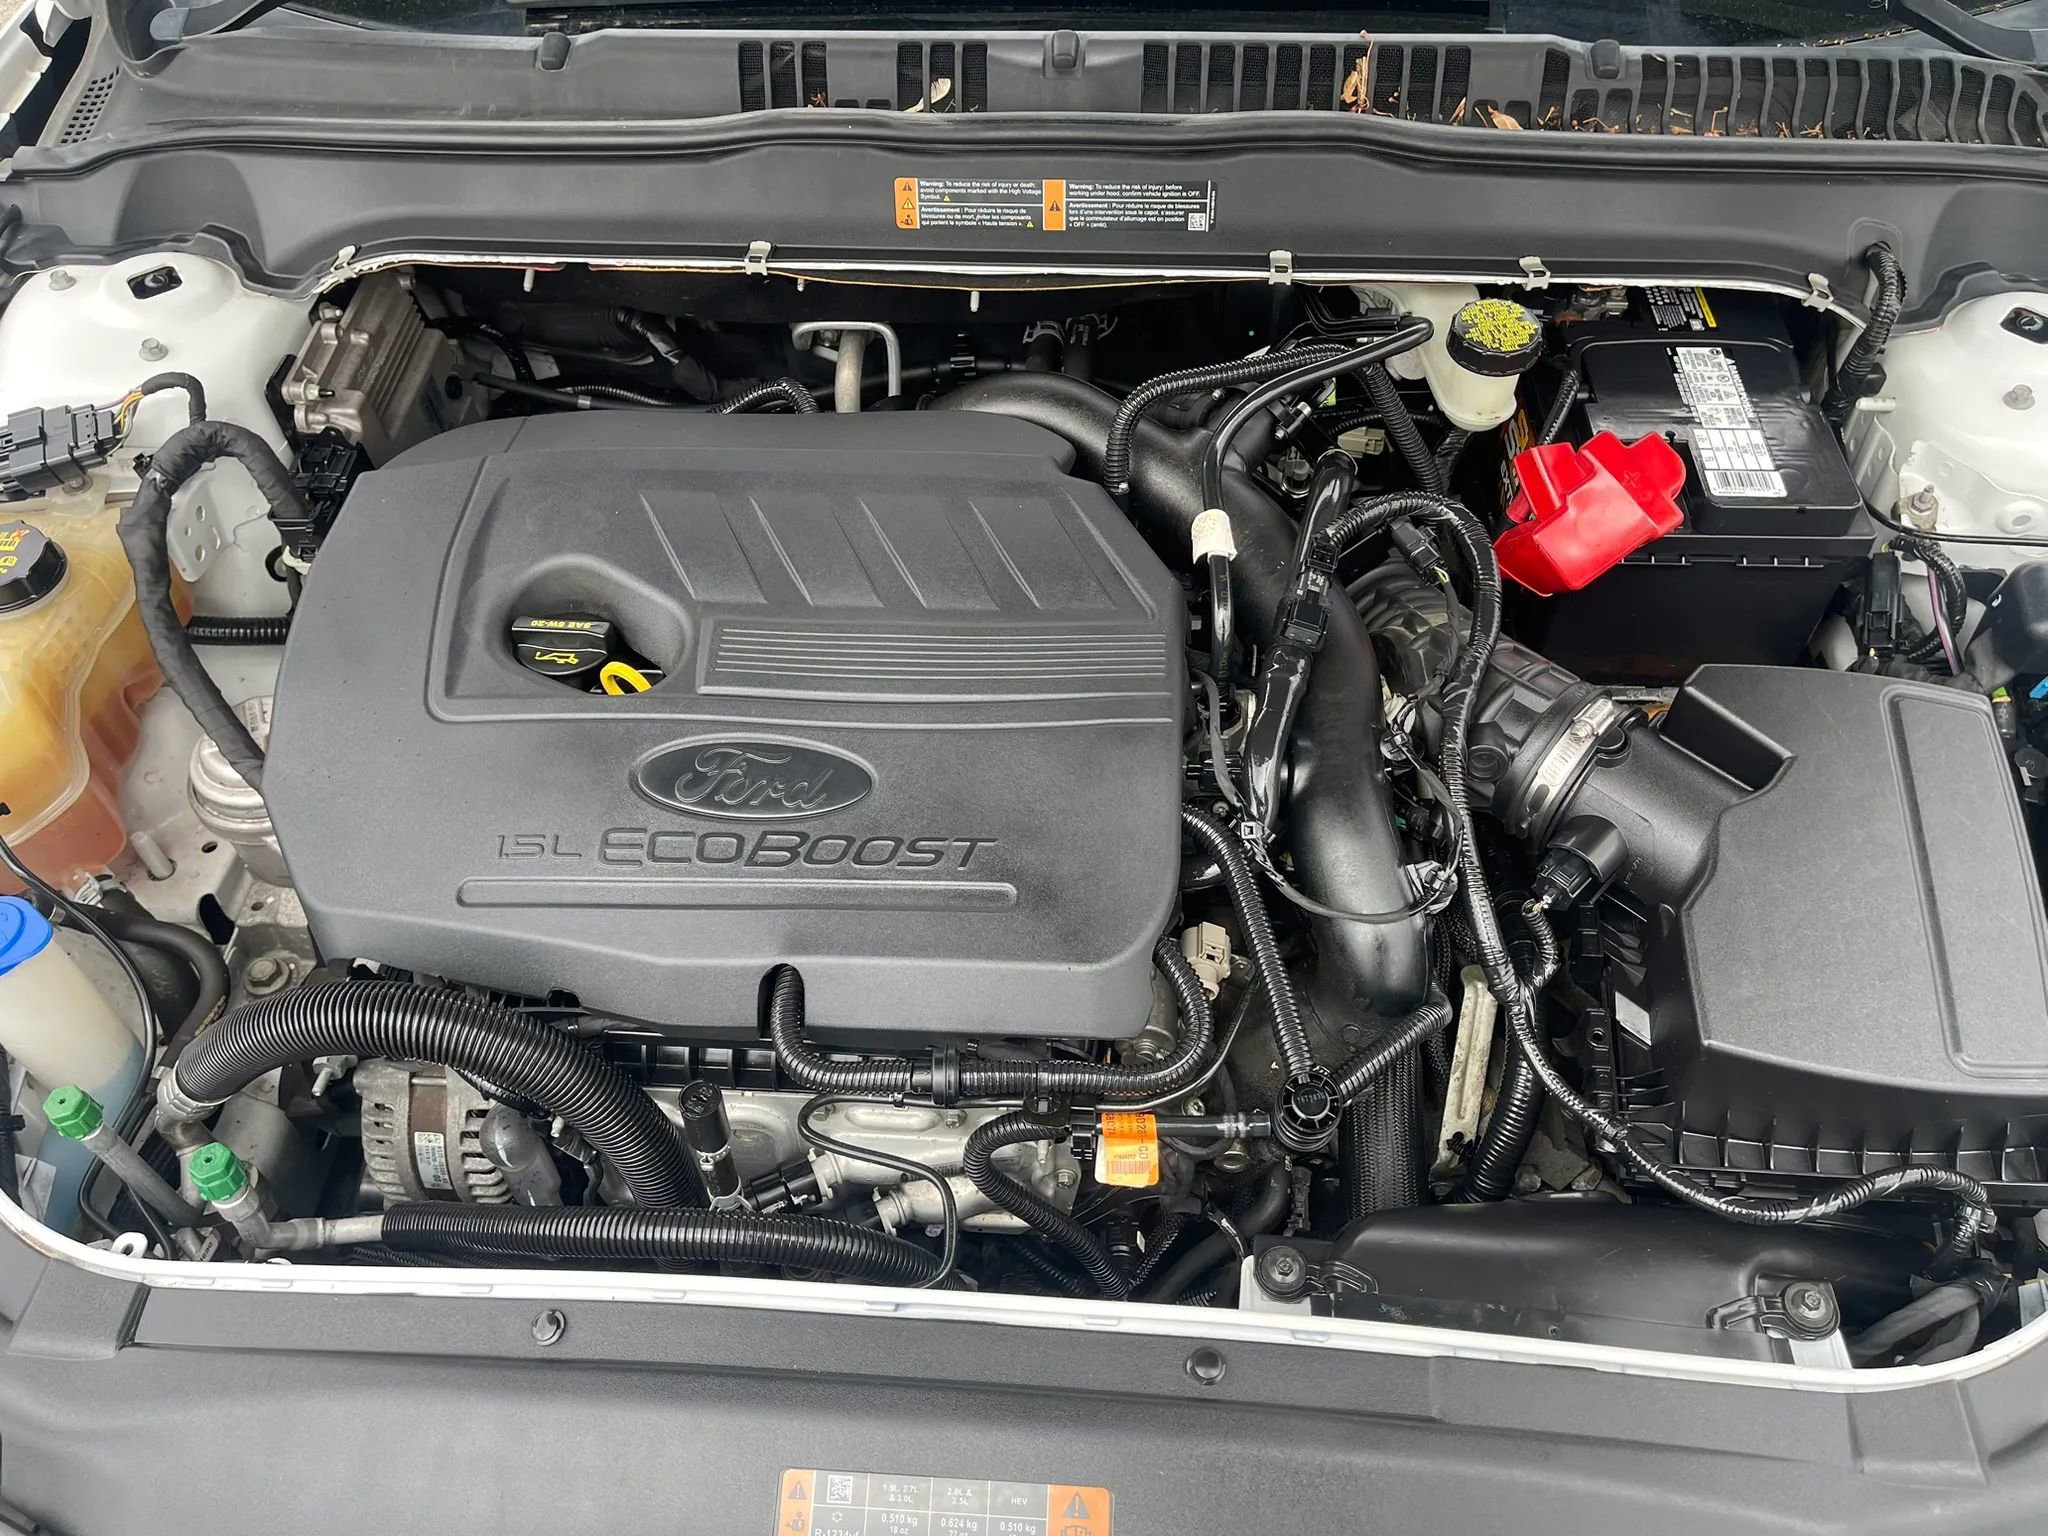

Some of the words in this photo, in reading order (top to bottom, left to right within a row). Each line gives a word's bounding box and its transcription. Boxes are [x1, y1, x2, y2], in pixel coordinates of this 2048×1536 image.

[530, 619, 567, 629] 5W-20
[567, 621, 592, 629] SAE
[674, 747, 835, 810] Ford
[1010, 1497, 1028, 1506] HEV
[881, 1512, 905, 1524] 0.510
[906, 1514, 918, 1527] kg
[940, 1517, 965, 1529] 0.624
[966, 1518, 978, 1531] kg
[889, 1525, 898, 1535] 18
[899, 1527, 909, 1535] oz
[999, 1521, 1024, 1533] 0.510
[1025, 1523, 1037, 1536] kg
